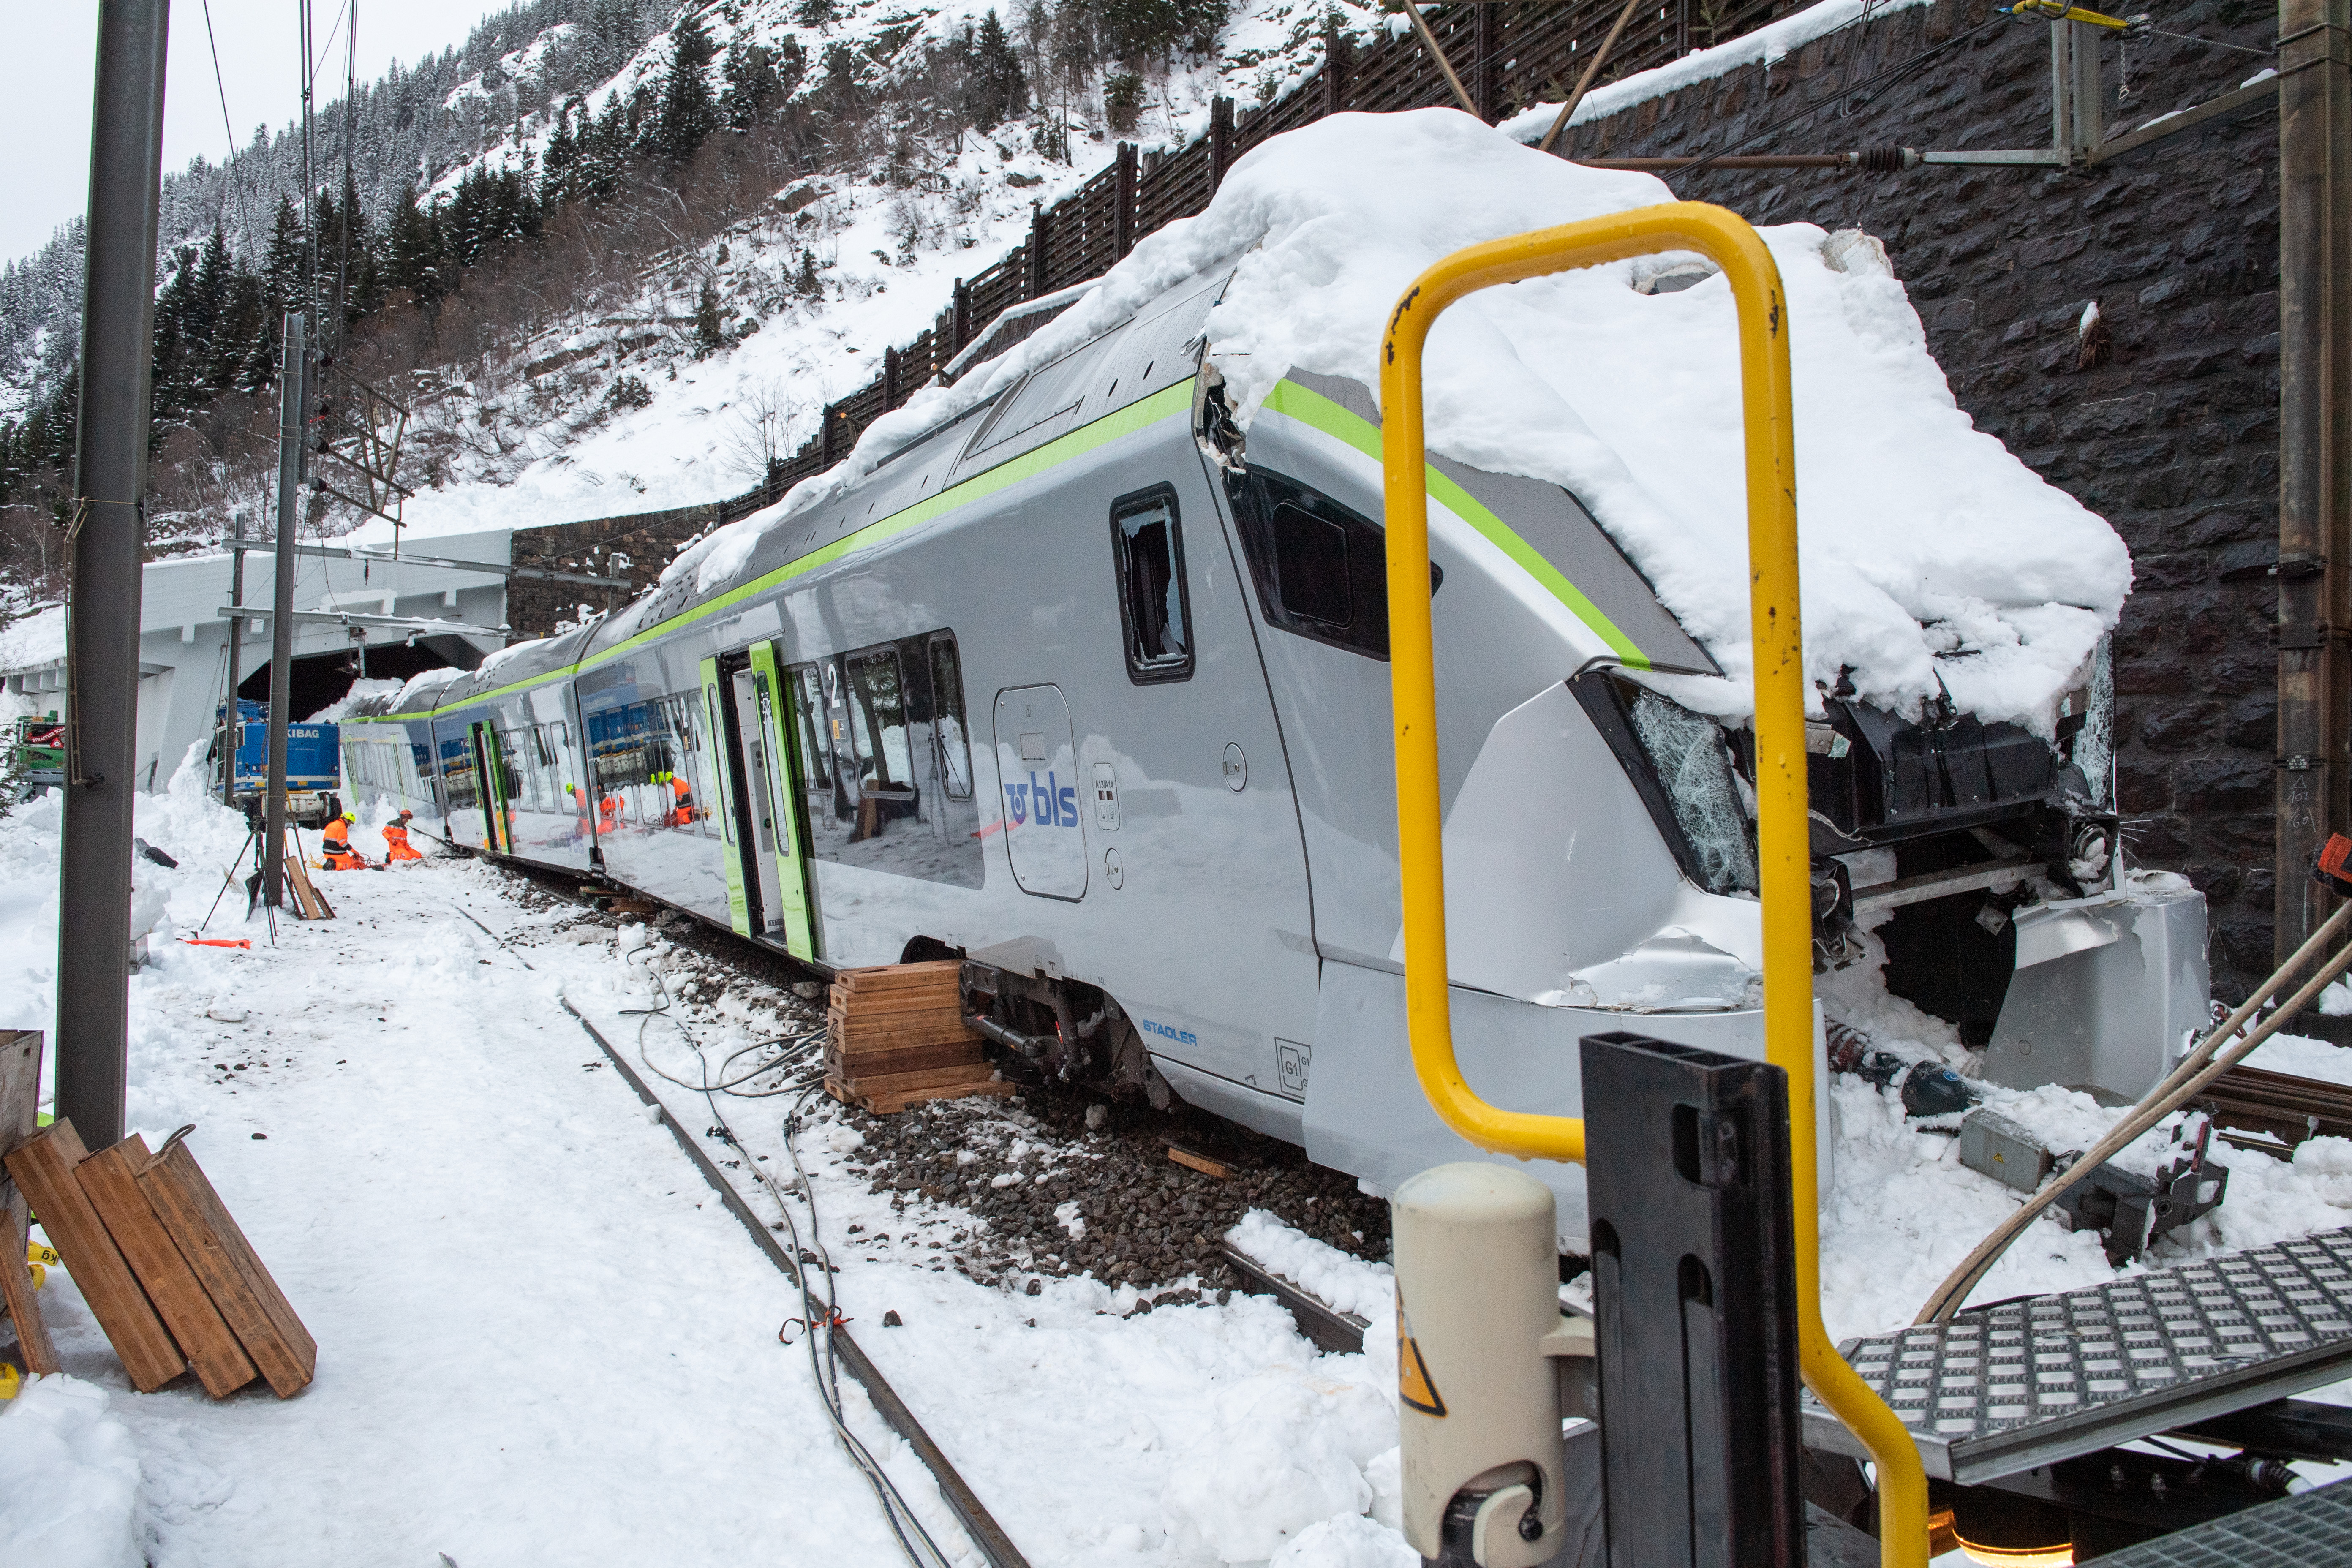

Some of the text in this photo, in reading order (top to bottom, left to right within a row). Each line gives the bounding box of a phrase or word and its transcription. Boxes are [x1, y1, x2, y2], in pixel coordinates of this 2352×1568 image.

[828, 663, 841, 708] 2
[681, 697, 688, 728] 2
[1095, 780, 1114, 789] A13/A14
[1030, 771, 1078, 828] bls
[1143, 1019, 1198, 1047] STADLER
[1285, 1060, 1298, 1077] G1
[1301, 1056, 1309, 1067] G1
[1302, 1078, 1309, 1087] G
